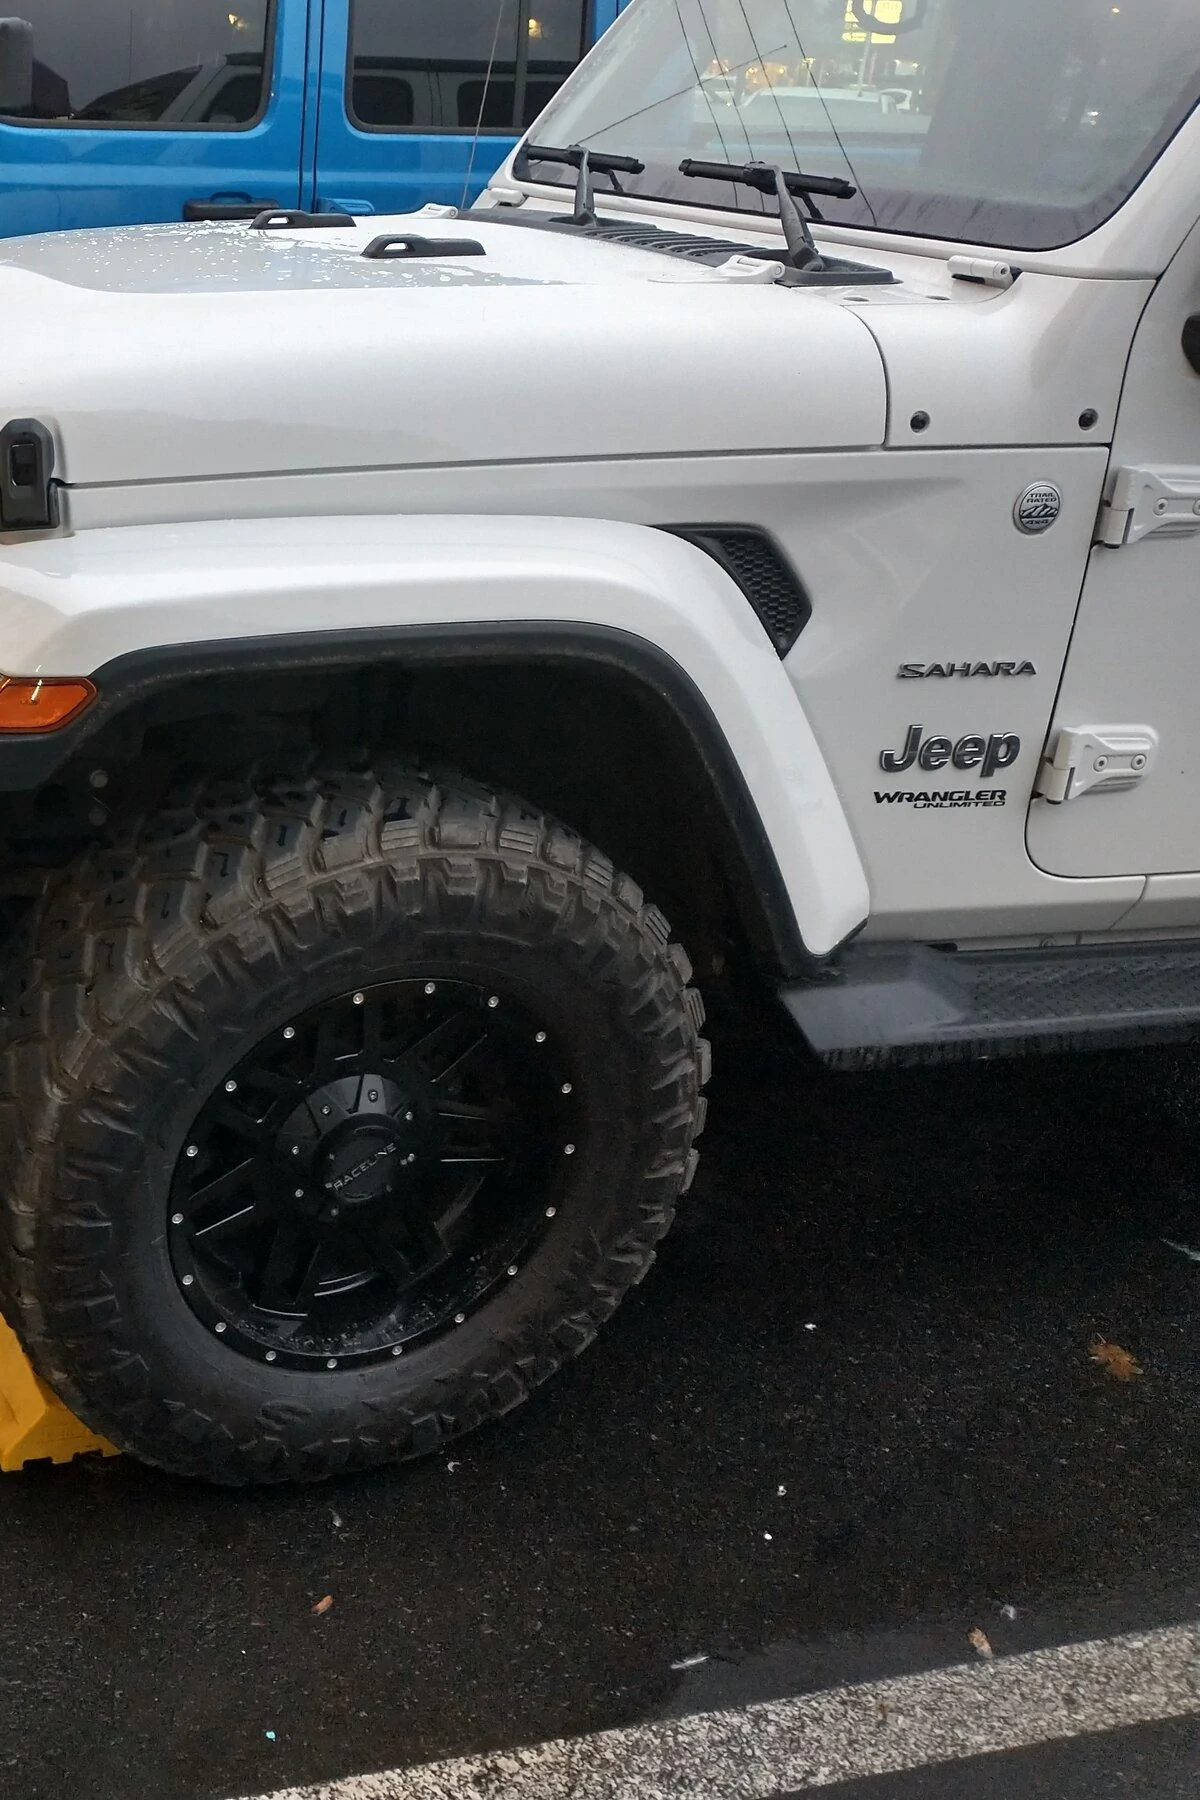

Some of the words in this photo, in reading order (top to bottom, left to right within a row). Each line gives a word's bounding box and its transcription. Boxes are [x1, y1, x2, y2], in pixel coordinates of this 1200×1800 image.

[897, 660, 1037, 679] SAHARA
[879, 724, 1021, 778] Jeep
[874, 789, 1007, 803] WRANGLER
[913, 801, 1006, 809] UNLIMITED
